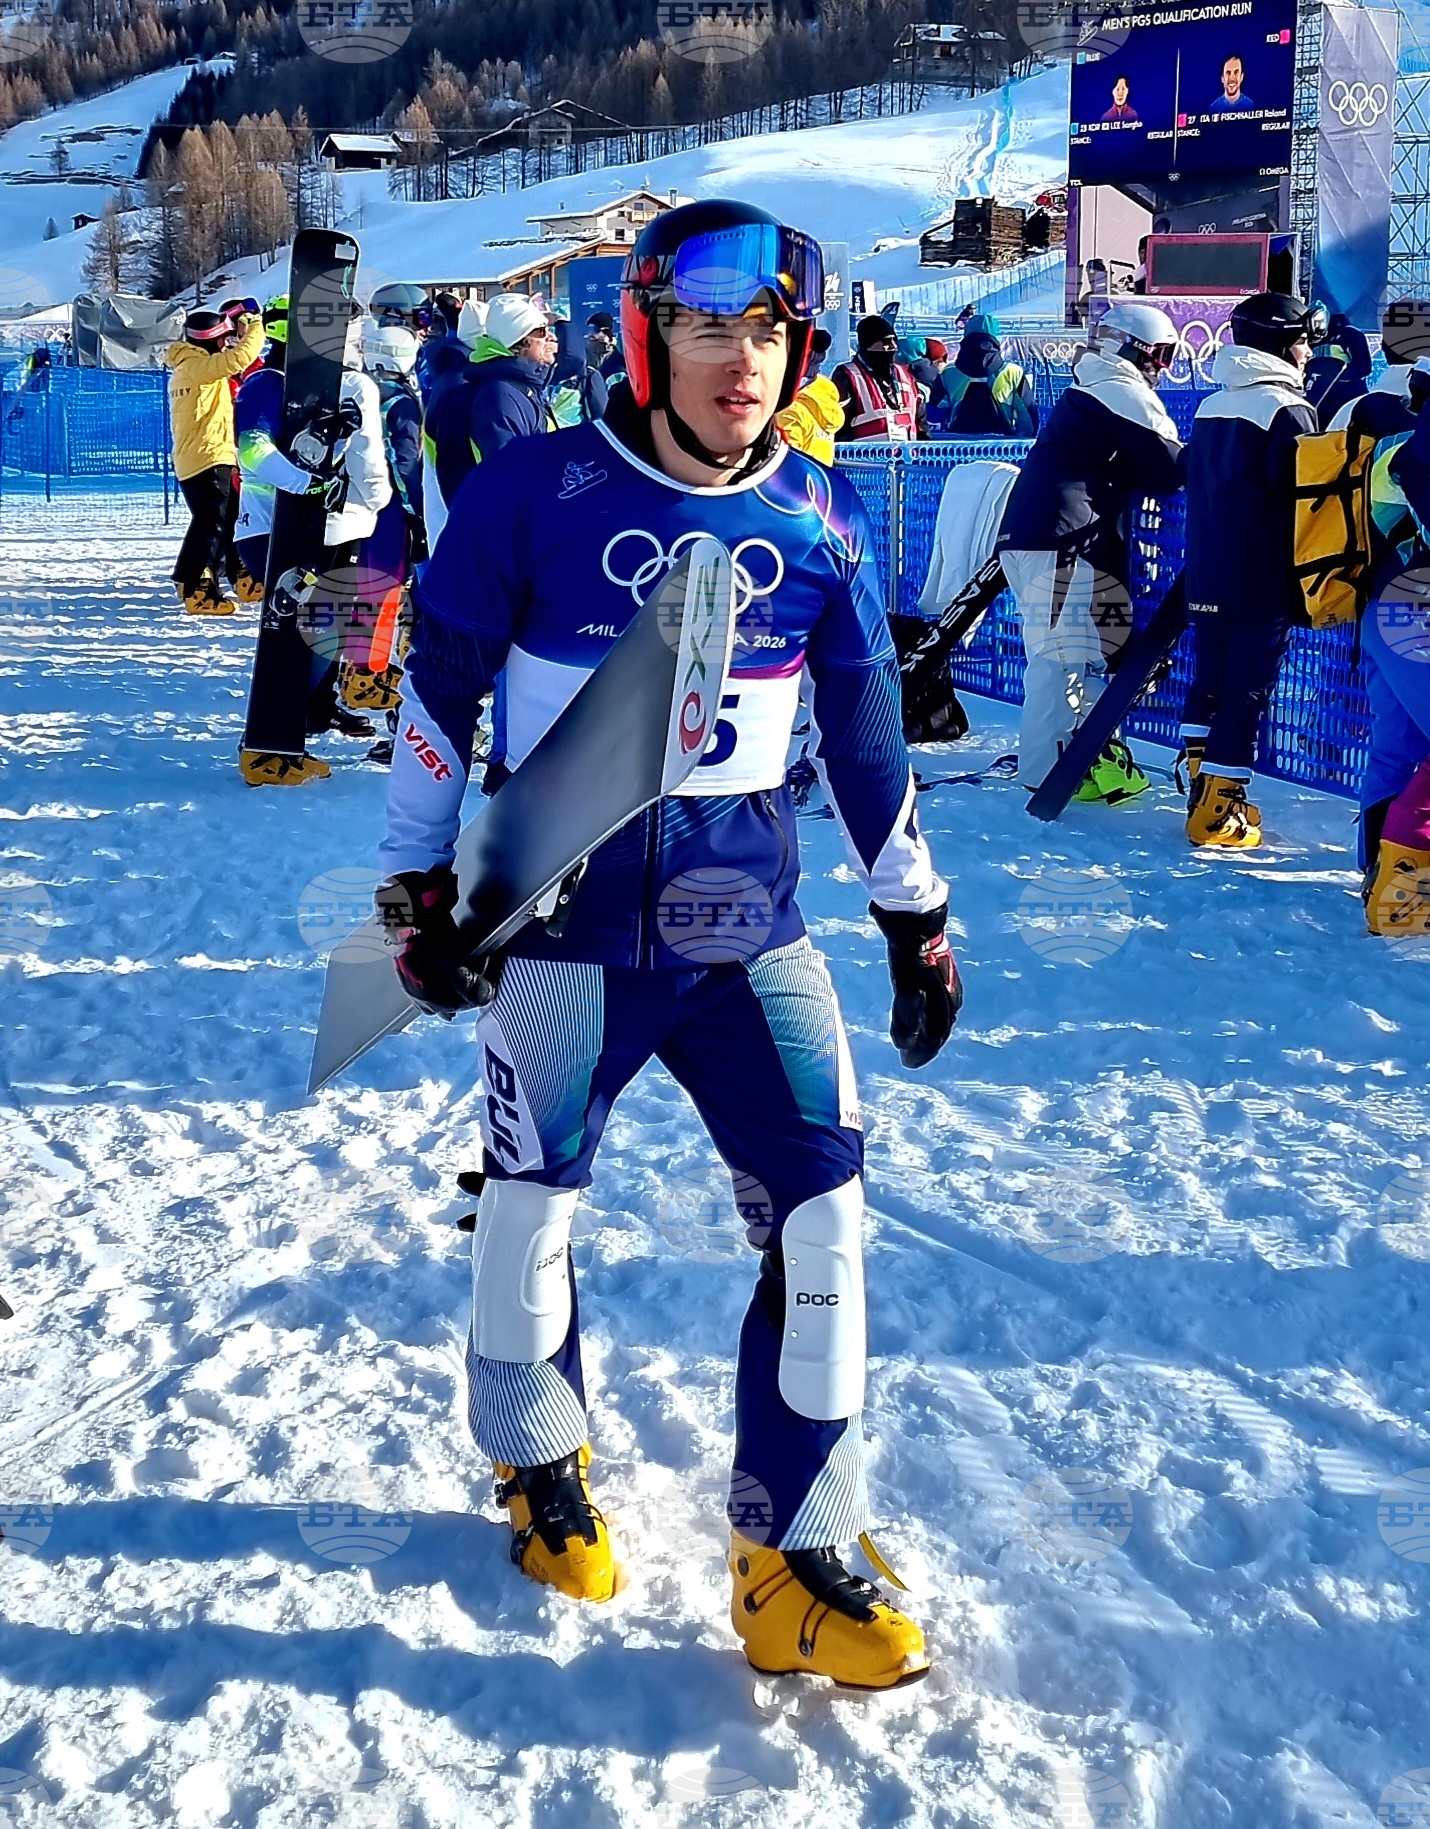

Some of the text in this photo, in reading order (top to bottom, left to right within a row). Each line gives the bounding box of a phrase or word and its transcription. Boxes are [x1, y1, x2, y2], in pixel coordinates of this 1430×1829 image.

[1132, 14, 1151, 27] PGS
[1153, 5, 1229, 25] QUALIFICATION
[1231, 2, 1252, 16] RUN
[576, 624, 626, 637] MIL
[753, 635, 787, 649] 2026
